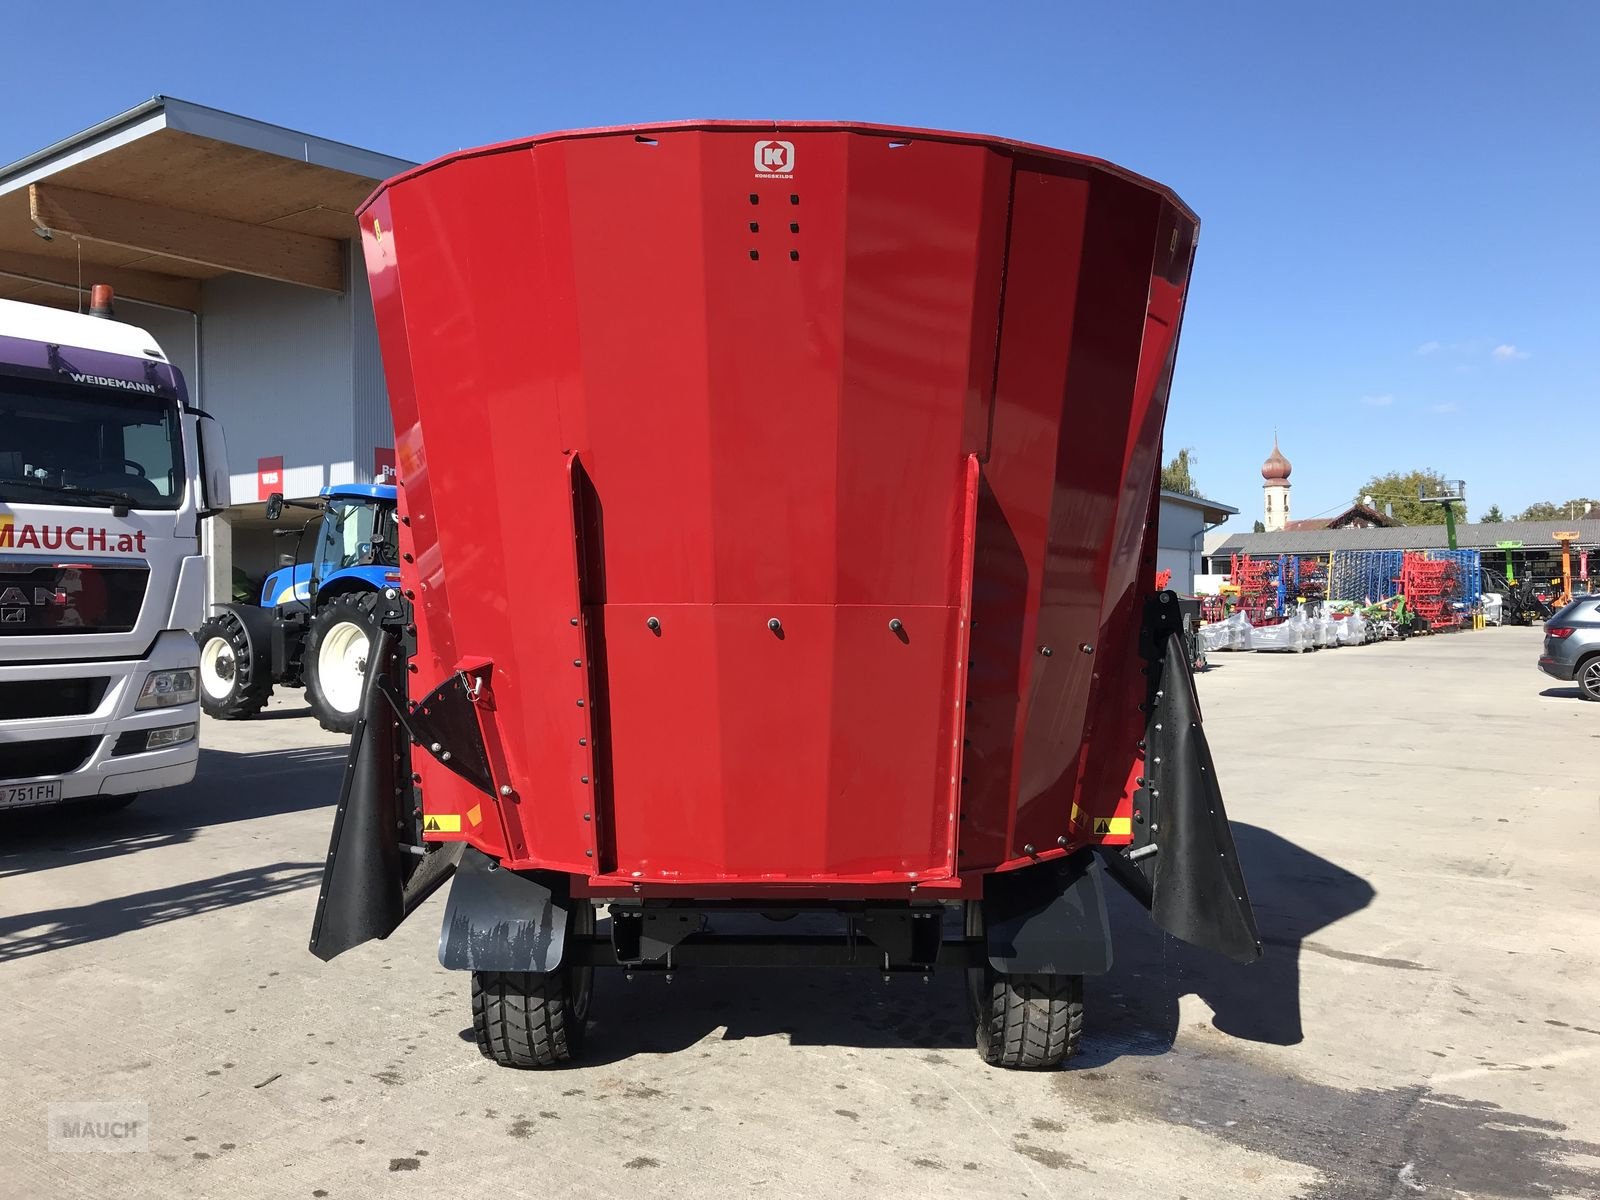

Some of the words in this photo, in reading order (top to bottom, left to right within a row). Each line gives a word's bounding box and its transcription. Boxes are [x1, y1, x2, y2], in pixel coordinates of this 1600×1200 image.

[764, 148, 784, 165] K
[70, 372, 155, 393] WEIDEMANN
[0, 523, 146, 553] MAUCH.at
